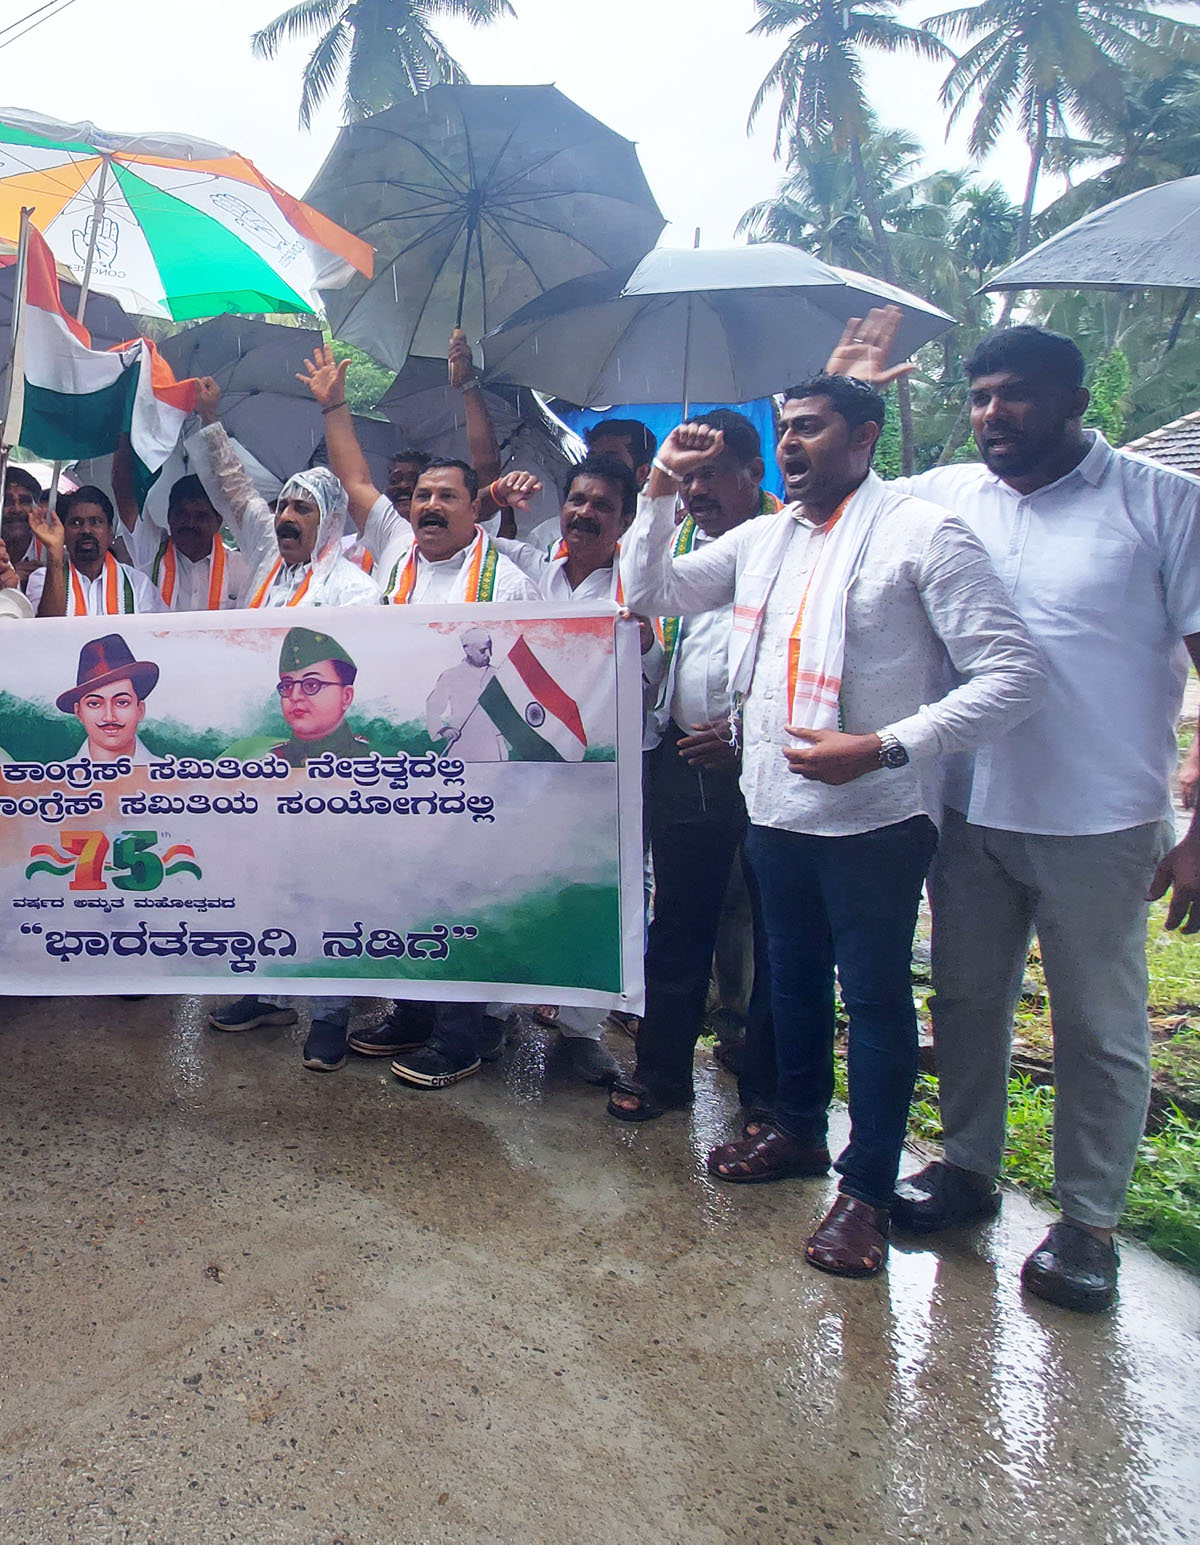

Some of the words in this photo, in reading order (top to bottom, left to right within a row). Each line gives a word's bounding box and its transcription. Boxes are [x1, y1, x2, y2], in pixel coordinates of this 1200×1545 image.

[3, 757, 131, 789] ಕಾಂಗ್ರೆಸ್
[149, 756, 289, 780] ಸಮಿತಿಯ
[121, 791, 258, 815] ಸಮಿತಿಯ
[277, 790, 495, 823] ಸಂಯೋಗದಲ್ಲಿ
[12, 897, 65, 910] ವರ್ಷದ
[73, 897, 125, 913] ಅಮೃತ
[133, 896, 236, 913] ಮಹೋತ್ಸವದ
